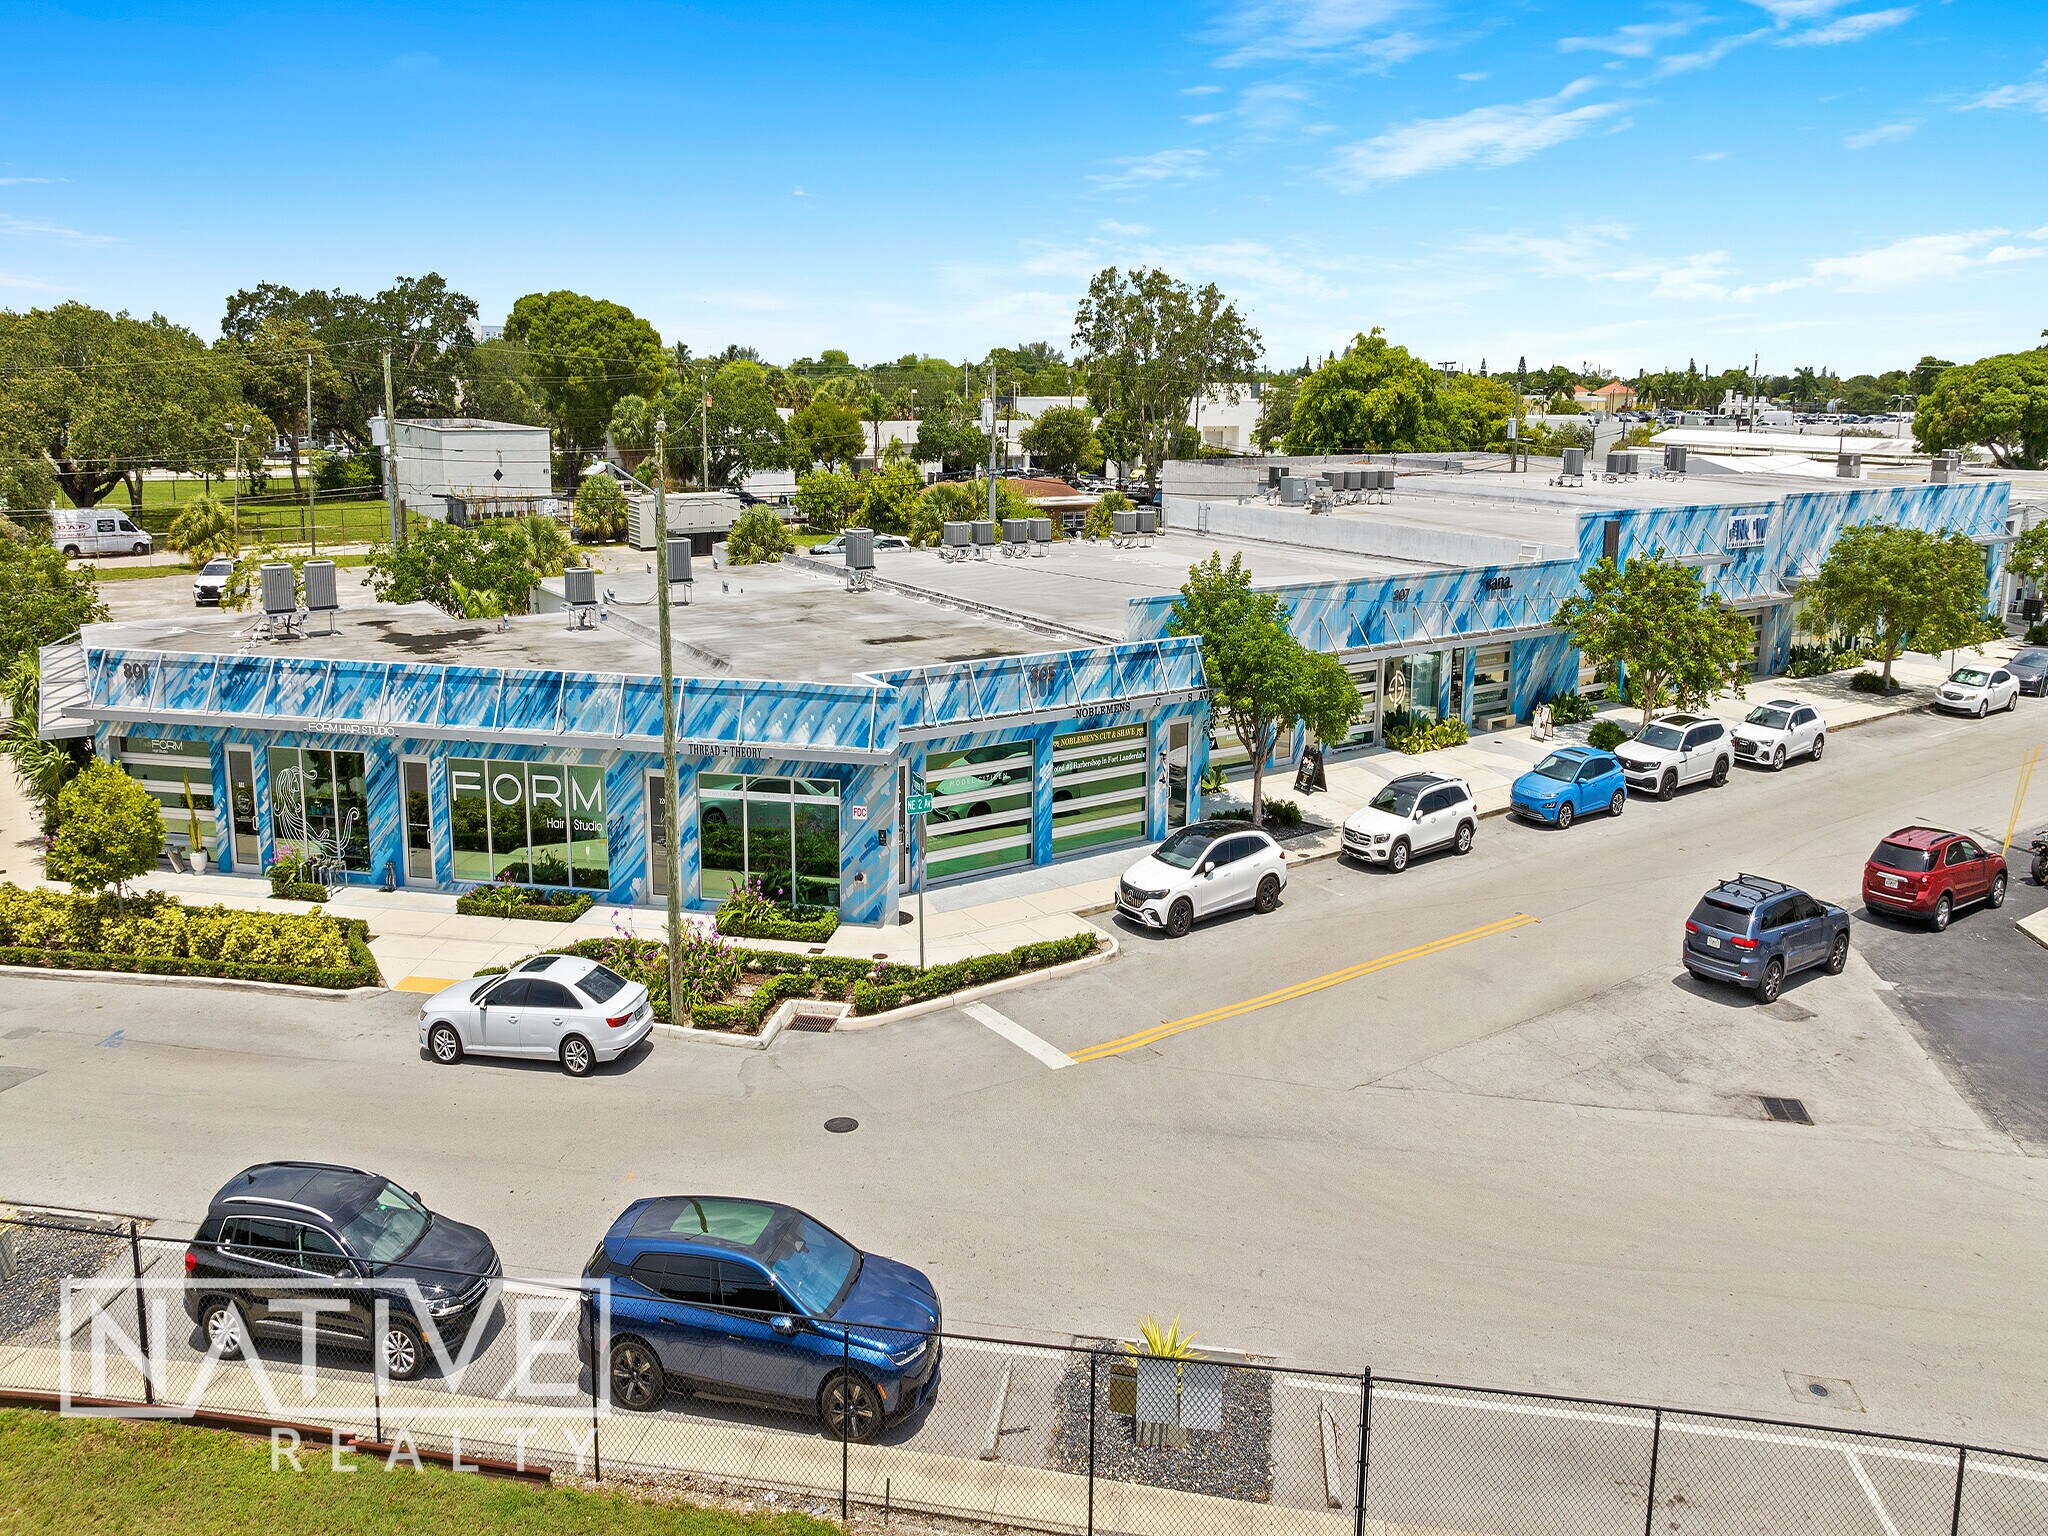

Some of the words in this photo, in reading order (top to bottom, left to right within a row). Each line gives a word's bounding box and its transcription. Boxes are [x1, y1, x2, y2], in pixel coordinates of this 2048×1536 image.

[1393, 588, 1410, 601] 807
[123, 662, 149, 680] 801
[1031, 665, 1056, 684] 805
[1075, 702, 1131, 719] NOBLEMENS
[308, 722, 338, 733] FORM
[339, 724, 360, 734] HAIR
[361, 725, 395, 736] STUDIO
[1100, 732, 1111, 740] CUT
[1117, 727, 1136, 738] SHAVE
[151, 739, 183, 751] FORM
[688, 743, 721, 757] THREAD
[730, 745, 762, 759] THEORY
[1073, 758, 1101, 770] Barbershop
[1101, 756, 1107, 764] in
[1108, 755, 1119, 764] Fort
[1119, 751, 1146, 762] Lauderdale
[949, 777, 975, 788] MODEL
[451, 770, 602, 813] FORM
[907, 799, 916, 811] NE
[918, 799, 923, 810] 2
[853, 807, 867, 818] FDC
[546, 817, 565, 829] Hair
[573, 819, 603, 832] Studio
